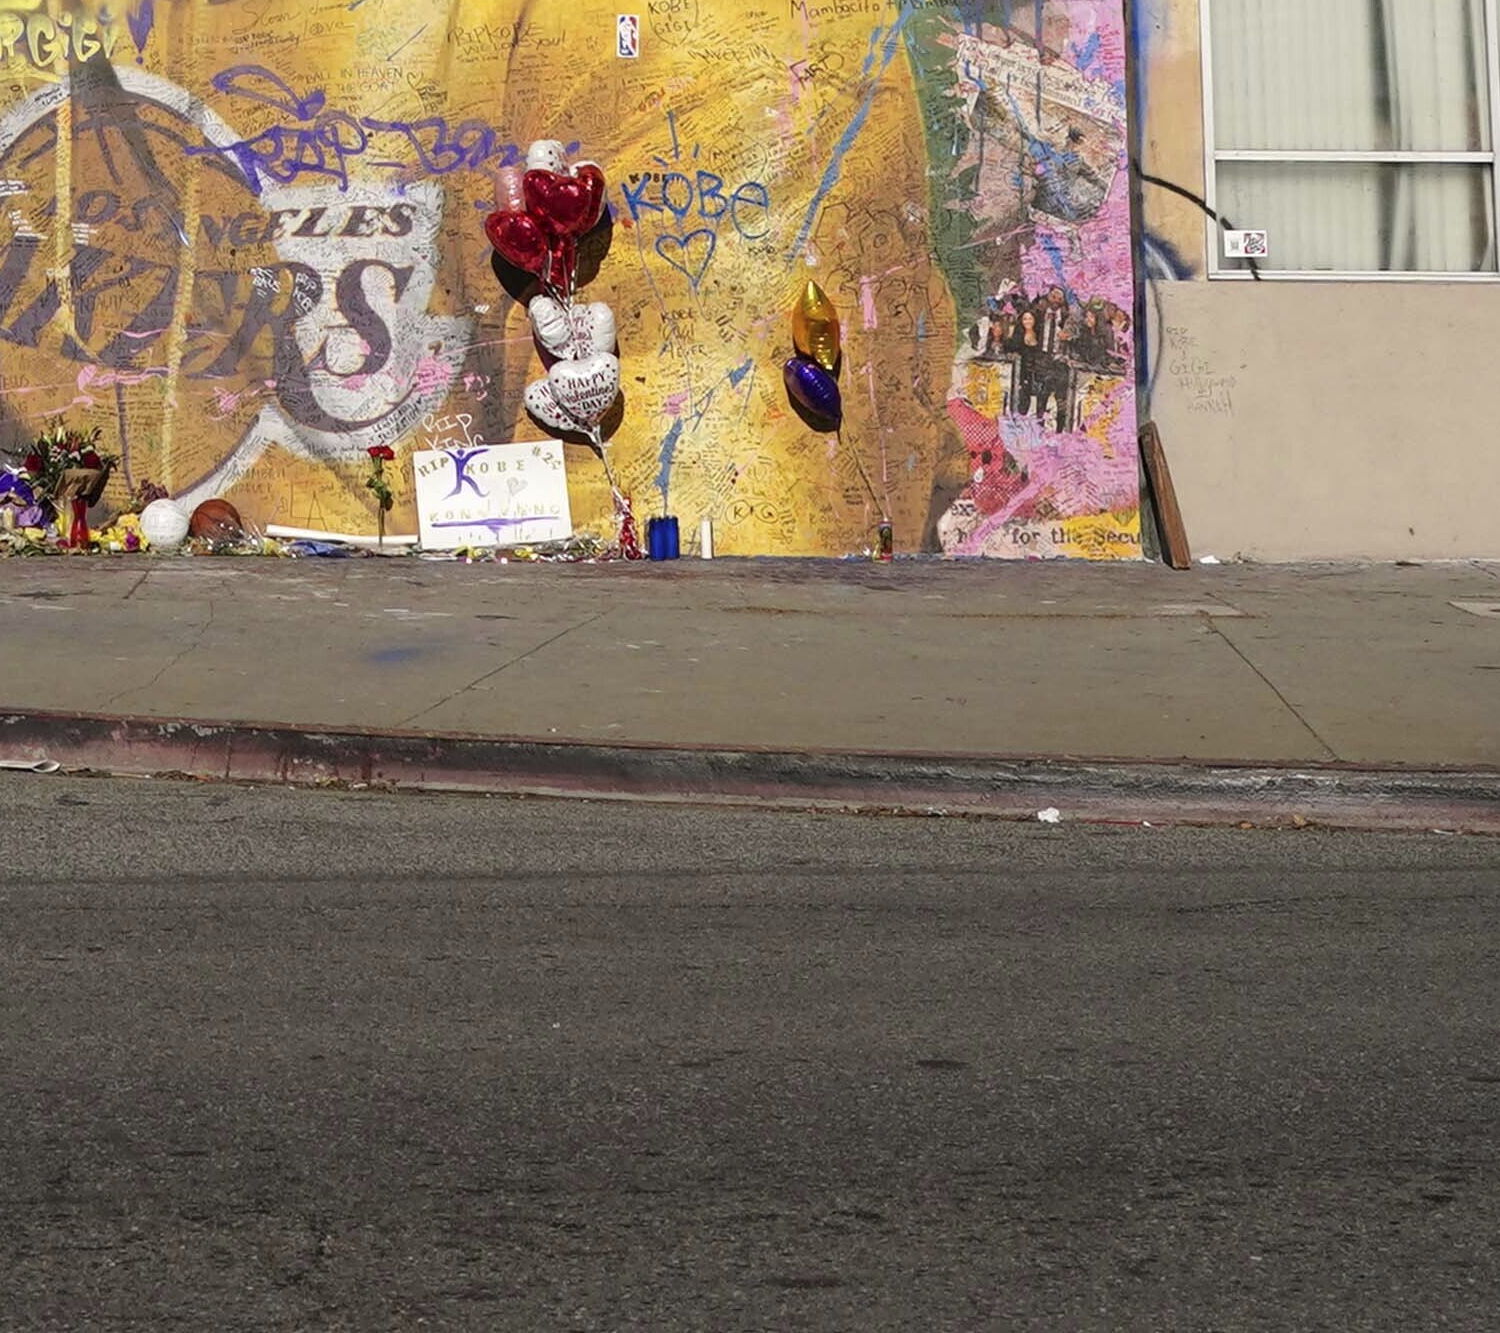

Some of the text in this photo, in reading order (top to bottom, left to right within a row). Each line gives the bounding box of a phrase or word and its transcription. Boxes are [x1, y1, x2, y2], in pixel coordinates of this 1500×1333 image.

[566, 371, 608, 391] HAPPY
[417, 456, 526, 478] RIP KOBE
